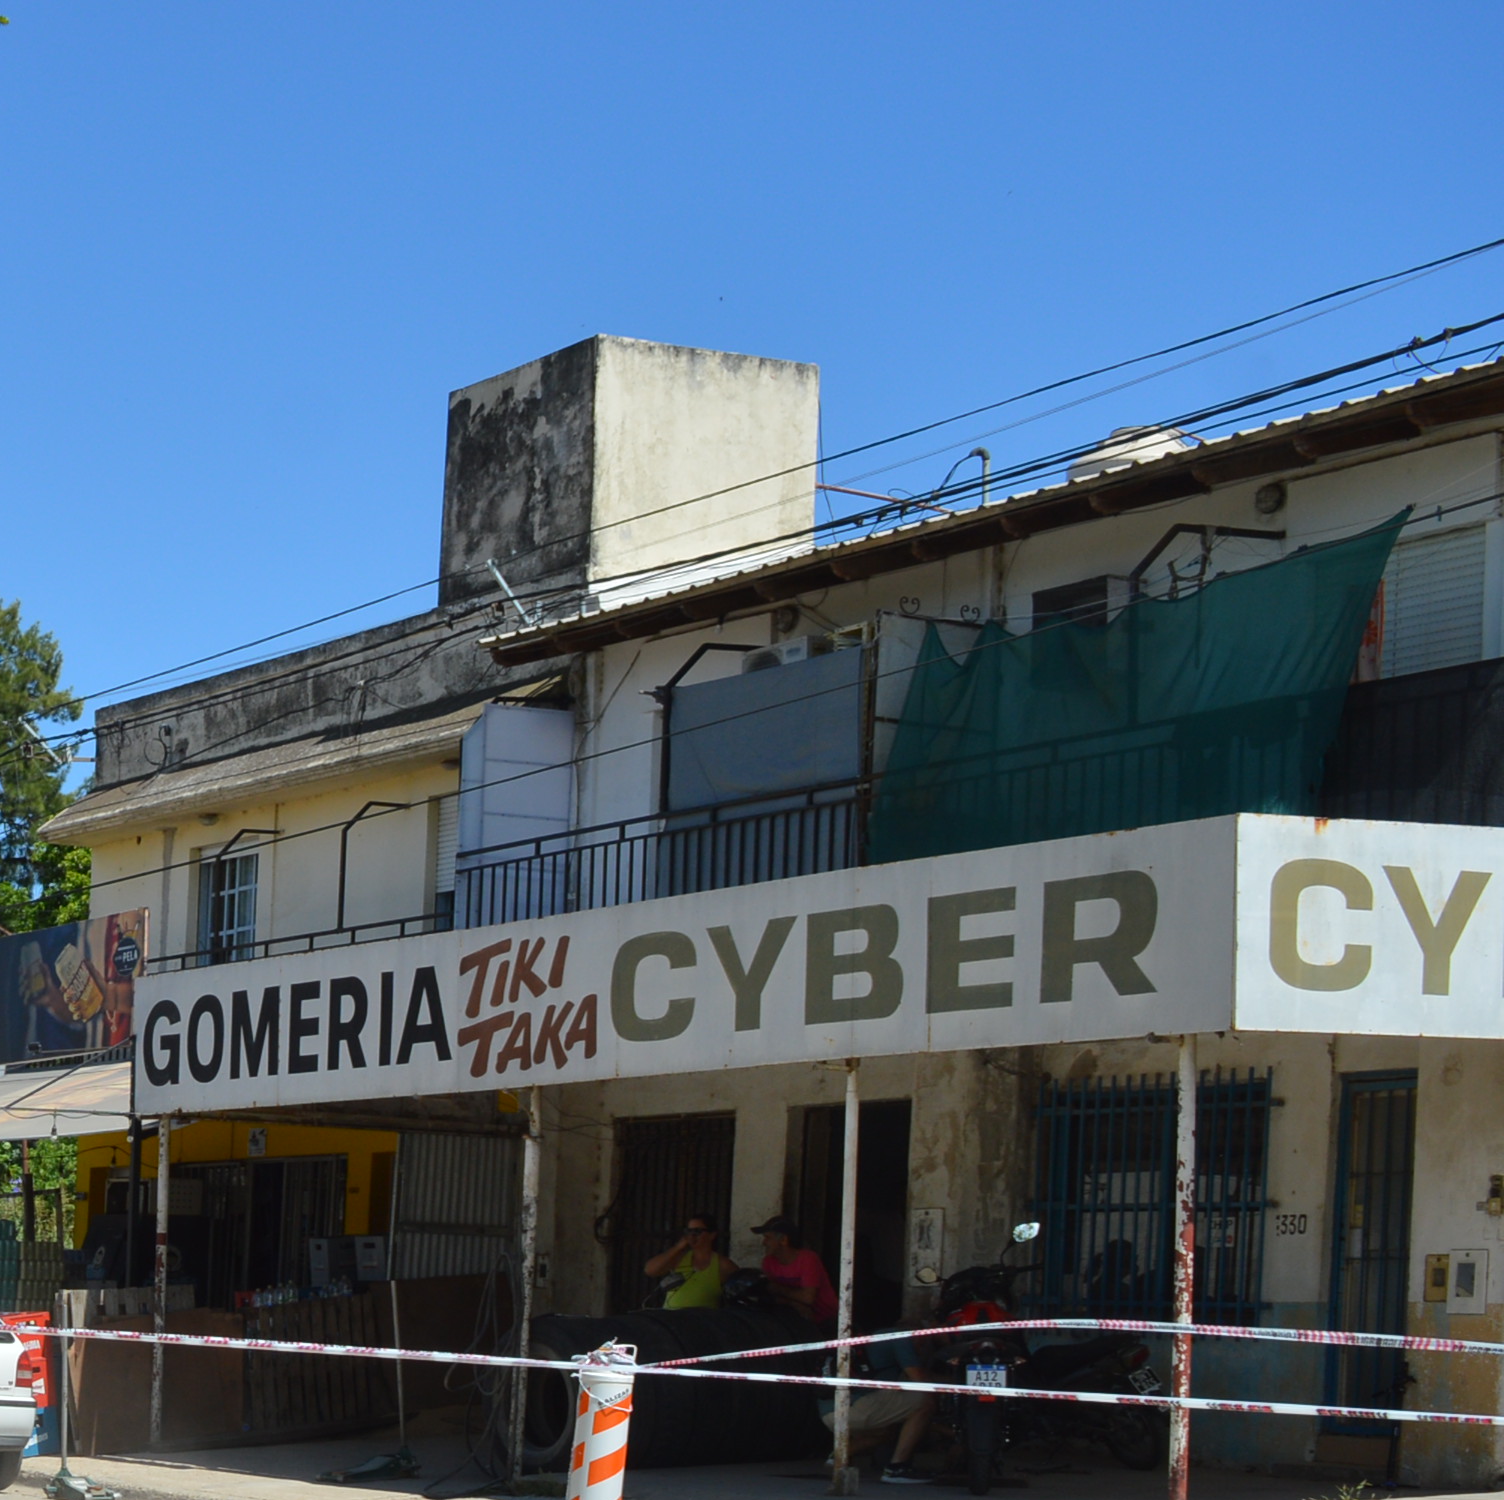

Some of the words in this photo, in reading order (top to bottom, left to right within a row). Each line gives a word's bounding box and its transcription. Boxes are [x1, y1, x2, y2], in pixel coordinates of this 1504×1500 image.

[459, 935, 570, 1019] TIKI
[610, 869, 1159, 1042] CYBER
[1268, 858, 1504, 998] CY
[142, 965, 453, 1087] GOMERIA
[457, 993, 598, 1078] TAKA
[975, 1371, 998, 1381] A12
